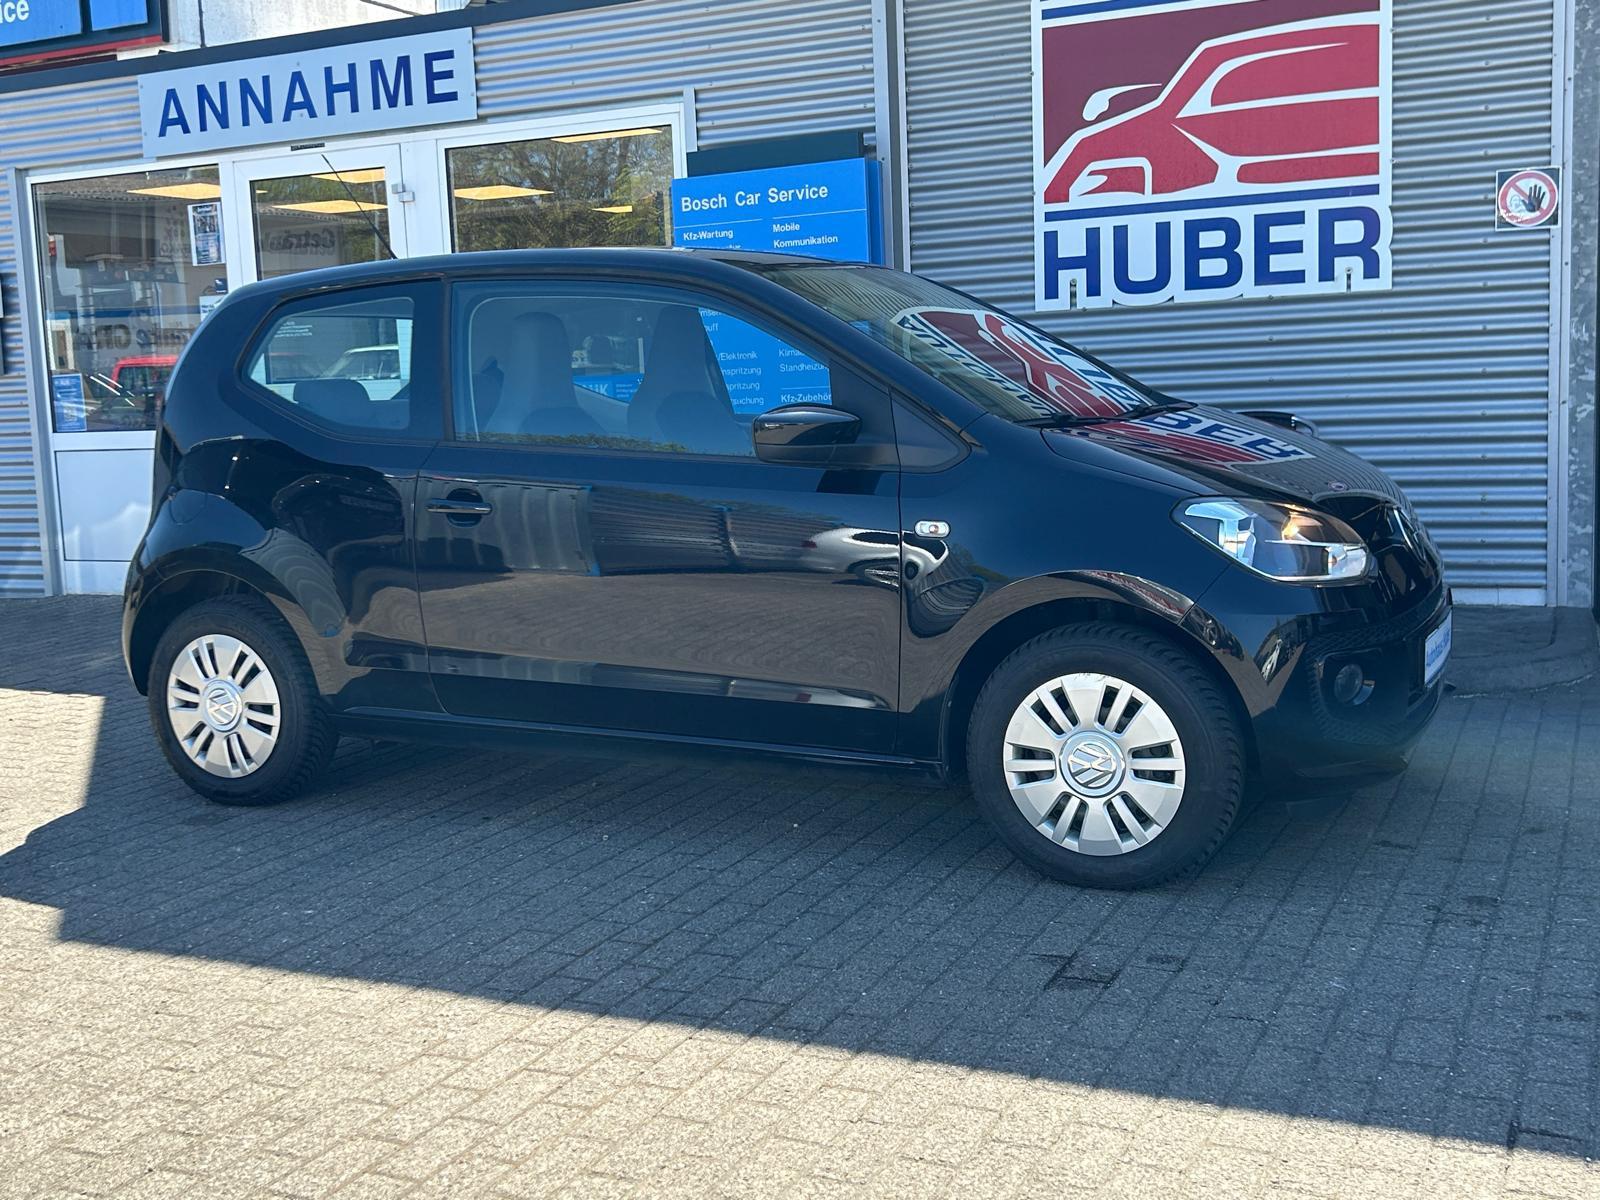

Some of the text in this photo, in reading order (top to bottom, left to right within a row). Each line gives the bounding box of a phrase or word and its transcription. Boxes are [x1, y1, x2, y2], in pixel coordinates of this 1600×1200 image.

[158, 49, 459, 138] ANNAHME
[681, 184, 828, 212] Bosch Car Service
[683, 229, 734, 241] Kfz-Wartung
[772, 222, 800, 233] Mobile
[773, 235, 838, 249] Kommunikation
[1044, 206, 1380, 300] HUBER
